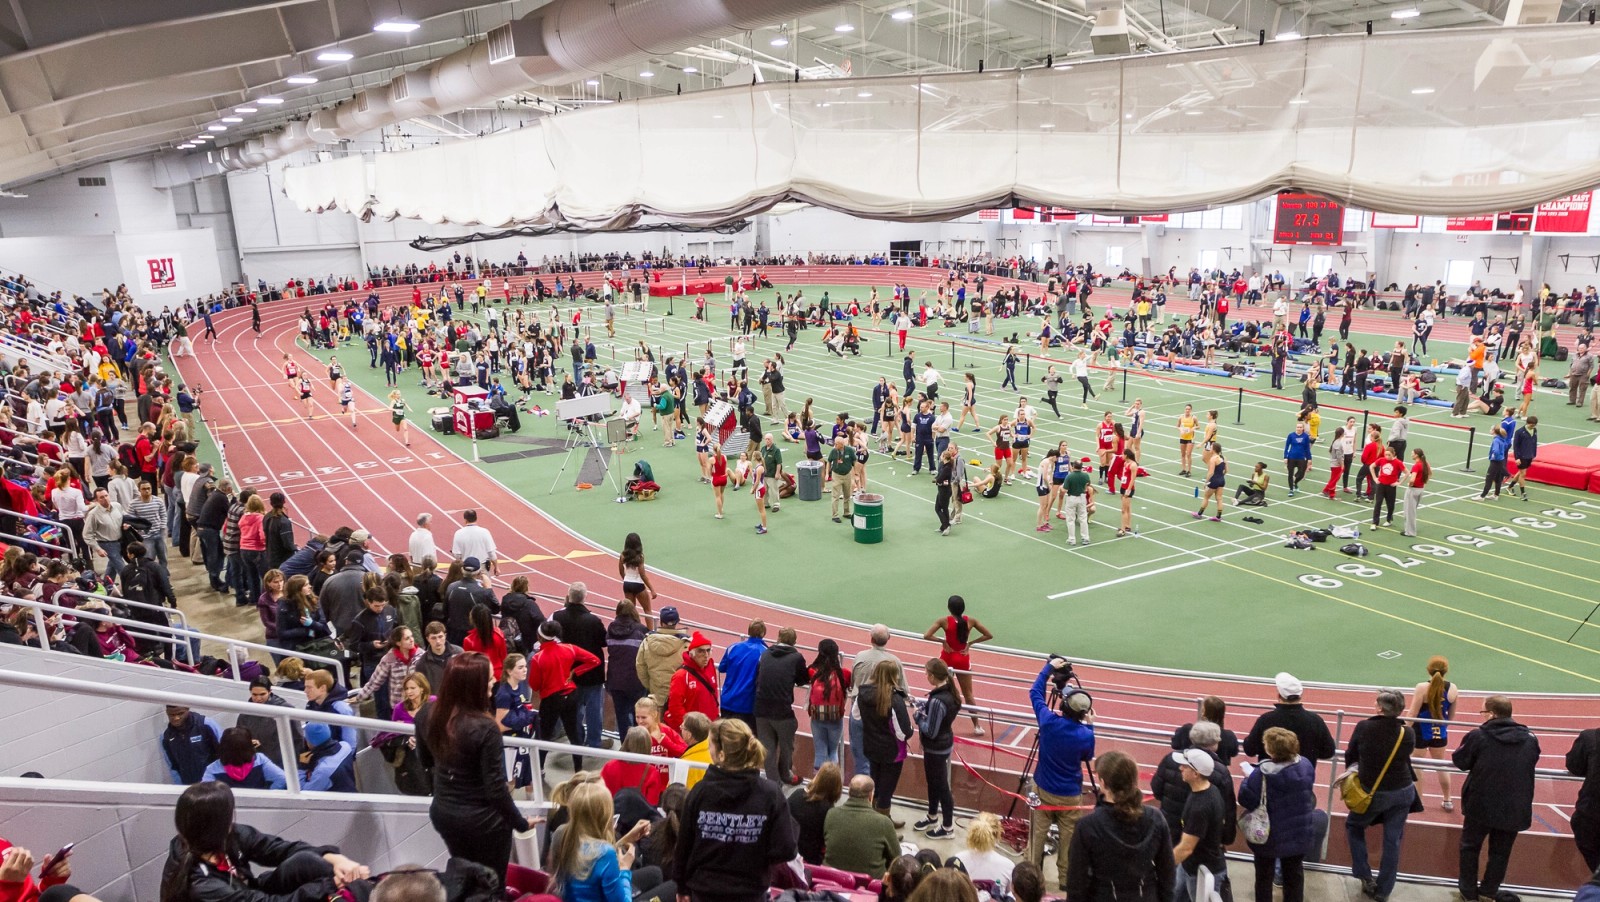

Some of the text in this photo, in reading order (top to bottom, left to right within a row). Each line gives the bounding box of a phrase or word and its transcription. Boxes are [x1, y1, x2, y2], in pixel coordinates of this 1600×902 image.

[1572, 194, 1590, 202] EAST
[1540, 202, 1589, 211] CHAMPIONS
[1293, 213, 1320, 227] 27.3
[147, 258, 175, 283] BU
[242, 452, 446, 484] 1 2 3 4 5 6
[1541, 508, 1587, 520] 2
[1511, 516, 1557, 529] 3
[1475, 525, 1519, 538] 4
[1446, 534, 1495, 548] 5
[1411, 544, 1455, 557] 6
[1377, 553, 1426, 568] 7
[1335, 563, 1383, 578] 8
[1298, 573, 1343, 588] 9
[697, 811, 767, 828] BENTLEY
[698, 824, 762, 836] CROSS COUNTRY
[701, 831, 727, 842] TRACK
[735, 835, 758, 843] FIELD
